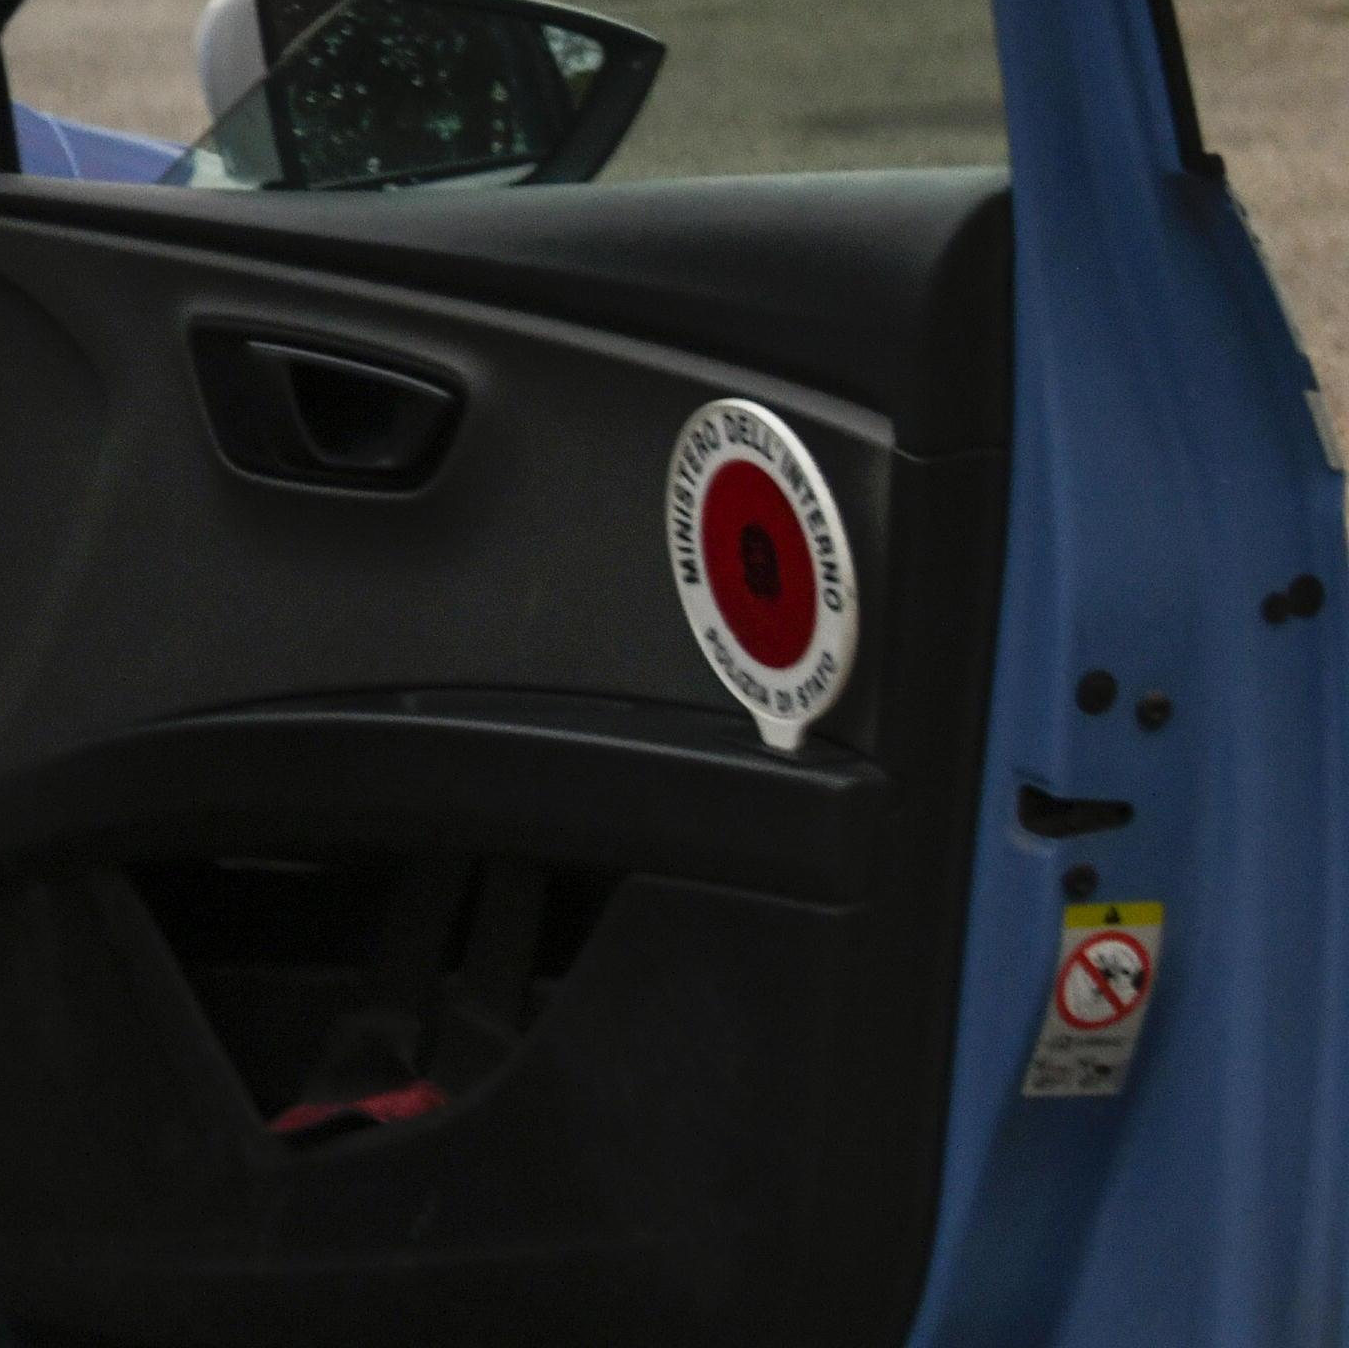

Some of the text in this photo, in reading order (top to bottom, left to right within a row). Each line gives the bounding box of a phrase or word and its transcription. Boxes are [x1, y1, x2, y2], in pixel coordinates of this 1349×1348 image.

[671, 419, 721, 584] MINISTERO
[775, 689, 795, 712] DI
[796, 650, 838, 710] STATO
